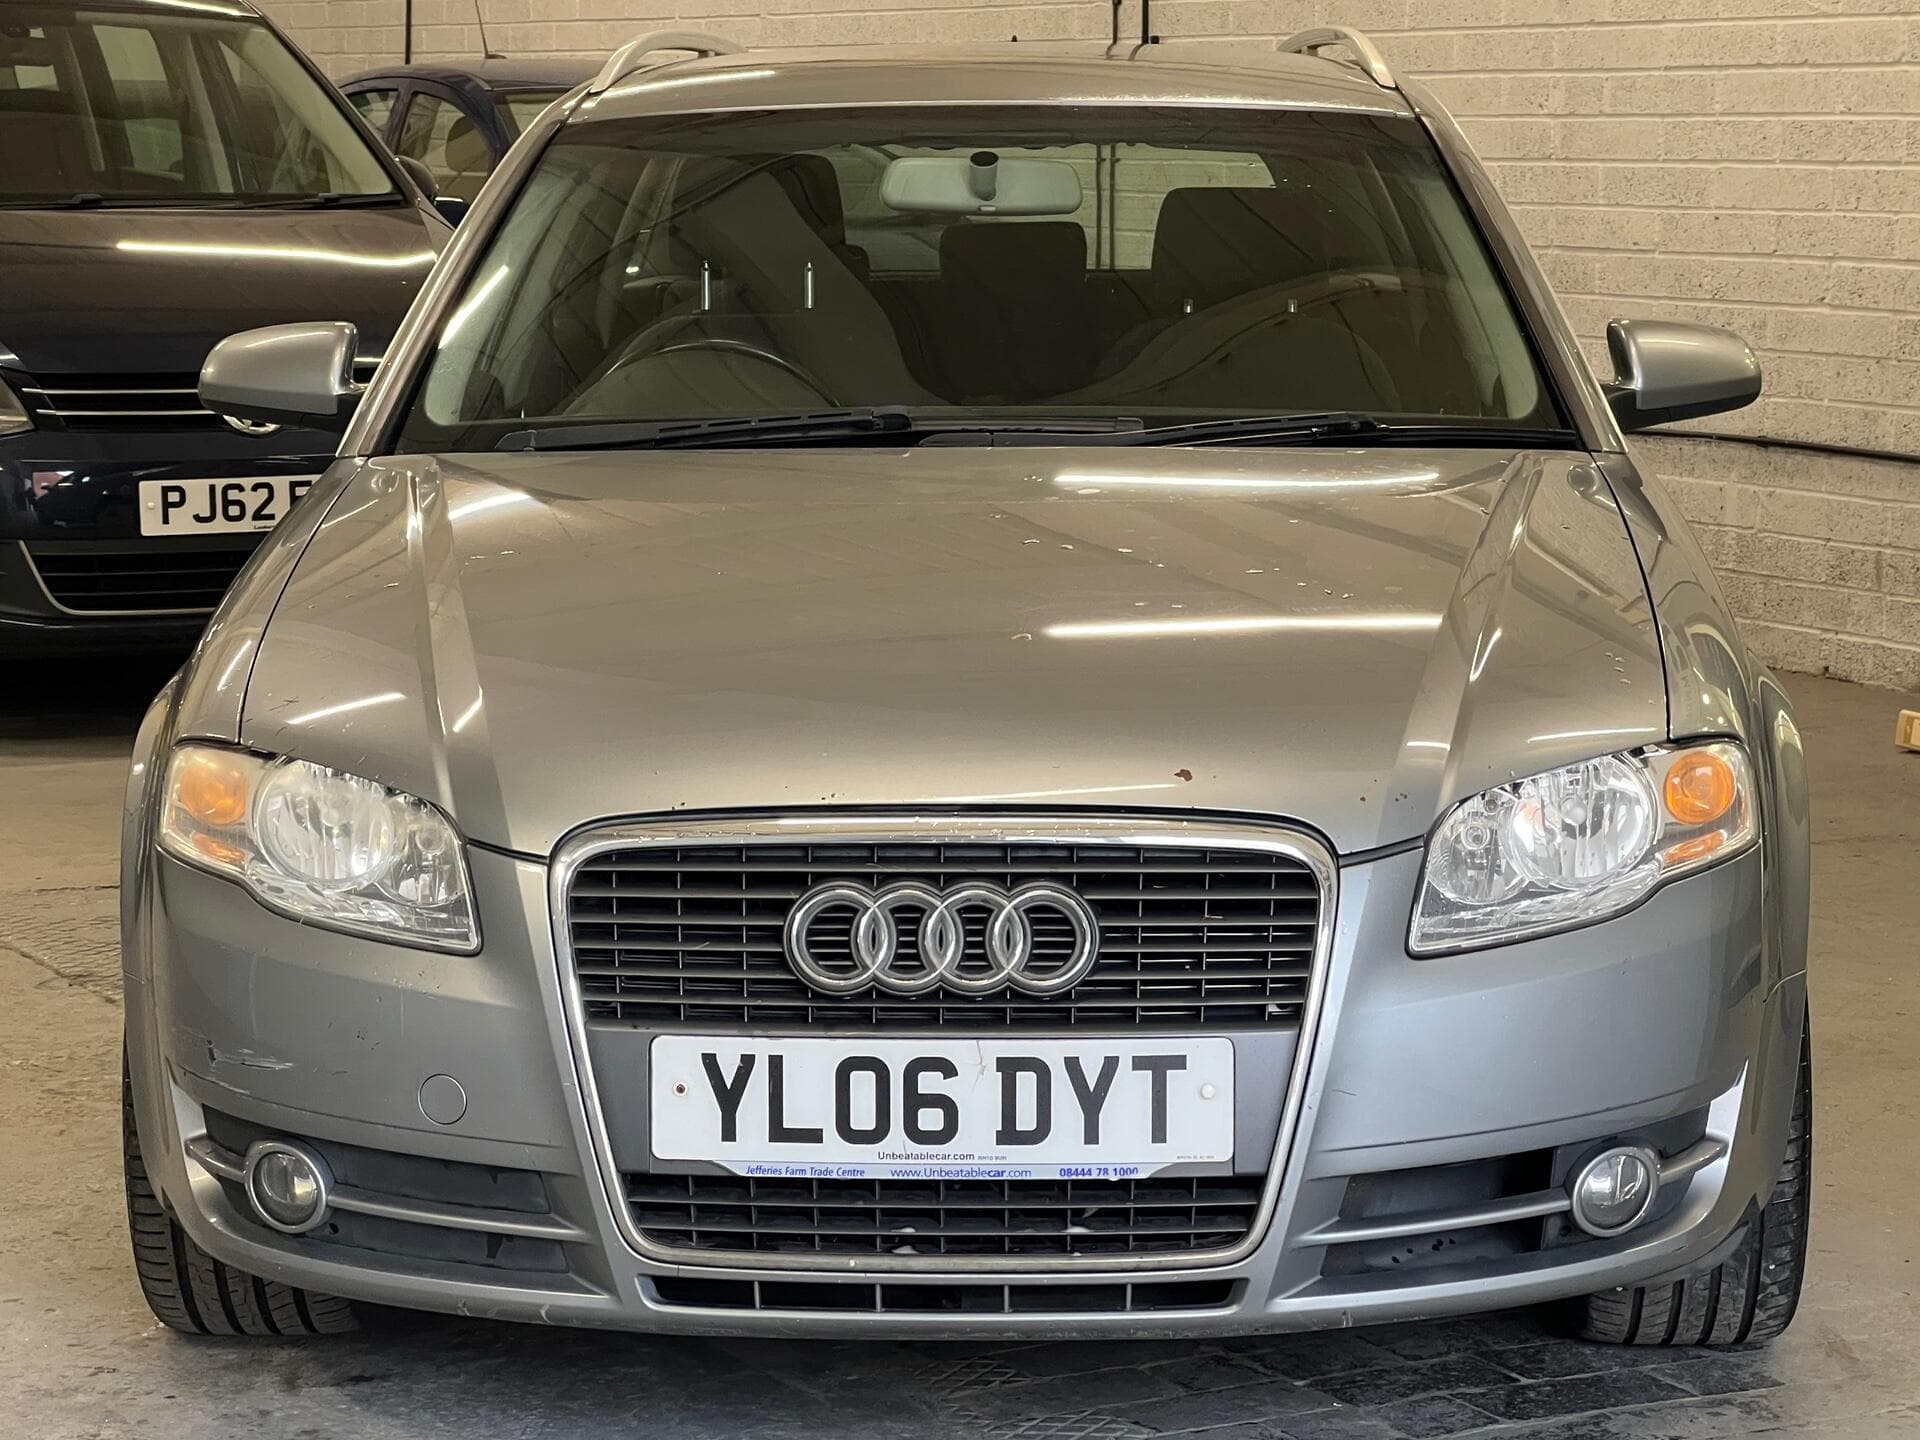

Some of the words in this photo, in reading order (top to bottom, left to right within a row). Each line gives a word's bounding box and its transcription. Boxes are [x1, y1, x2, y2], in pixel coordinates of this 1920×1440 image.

[161, 482, 275, 525] PJ62
[701, 1052, 959, 1146] YL06
[995, 1055, 1188, 1146] DYT
[877, 1151, 975, 1161] Unbeatablecar.com
[745, 1164, 783, 1177] Jefferies
[784, 1165, 807, 1176] Farm
[809, 1166, 834, 1177] Trade
[836, 1167, 866, 1177] Centre
[890, 1167, 1032, 1178] www.Unbeatablecar.com
[1059, 1167, 1091, 1177] 08444
[1113, 1167, 1139, 1176] 1000
